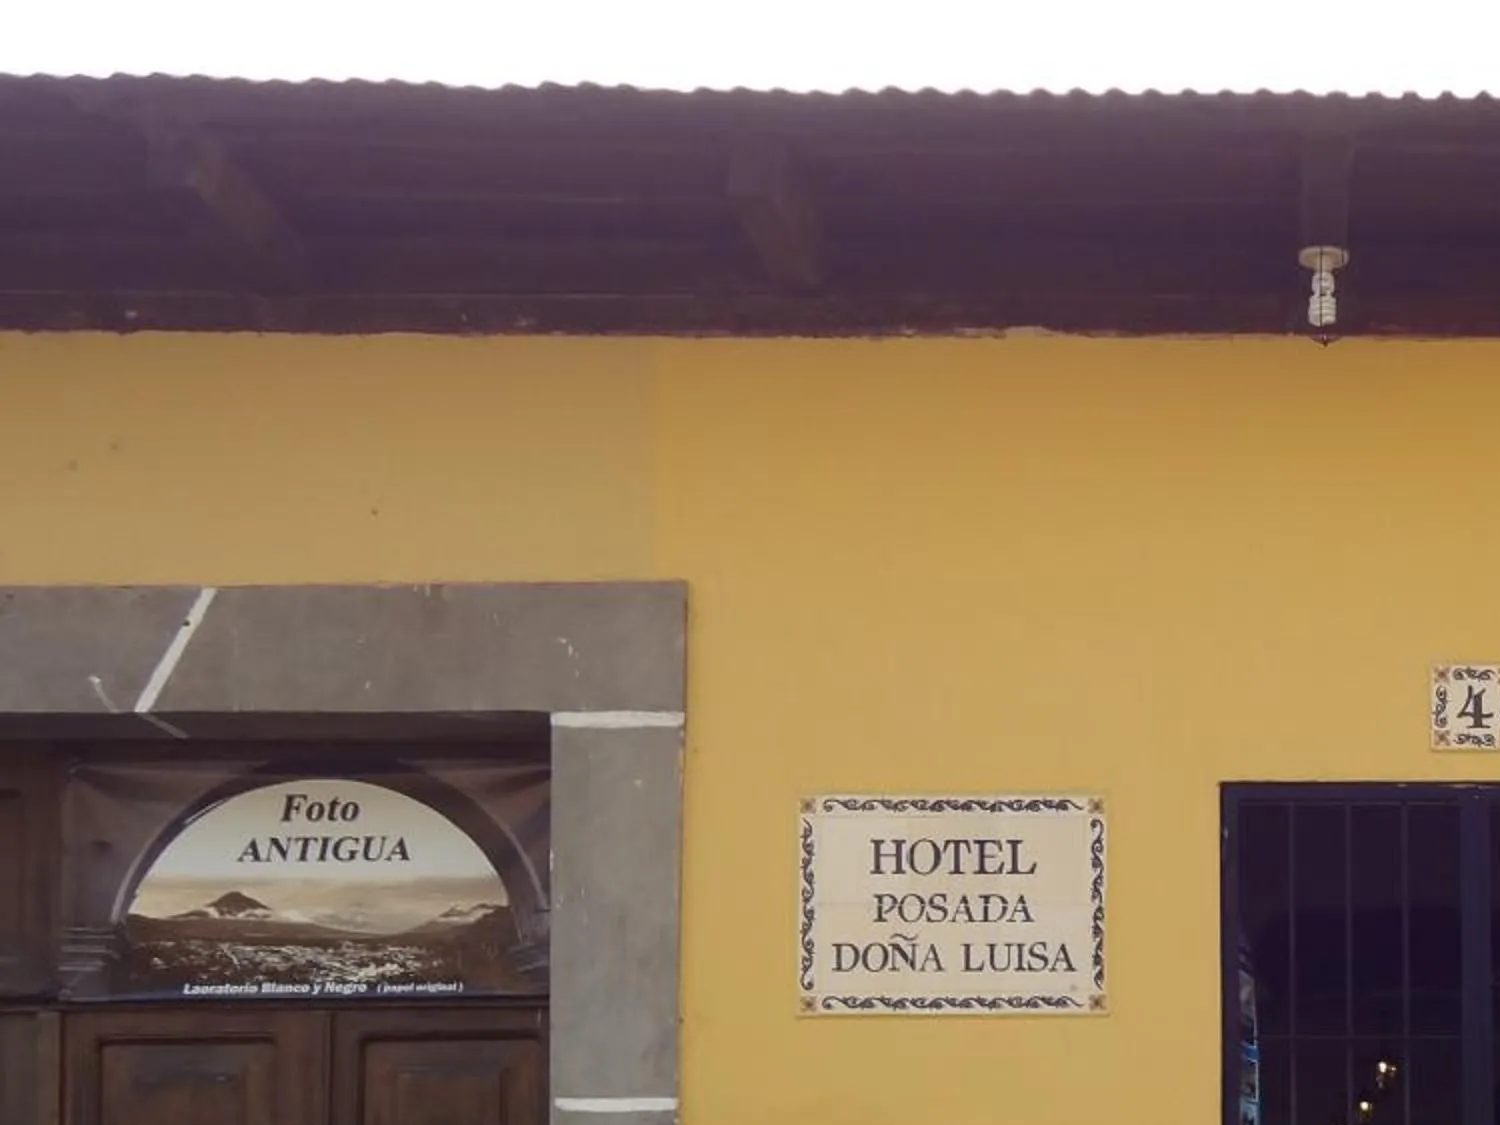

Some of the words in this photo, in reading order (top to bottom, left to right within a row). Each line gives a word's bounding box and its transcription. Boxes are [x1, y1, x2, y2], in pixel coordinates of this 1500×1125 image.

[1456, 685, 1494, 729] 4
[280, 793, 361, 823] Foto
[237, 835, 411, 863] ANTIGUA
[869, 837, 1038, 876] HOTEL
[872, 893, 1035, 924] POSADA
[831, 932, 946, 974] DOÑA
[960, 941, 1077, 974] LUISA
[261, 981, 310, 993] Blanco
[312, 983, 322, 995] y
[324, 981, 368, 994] Negro
